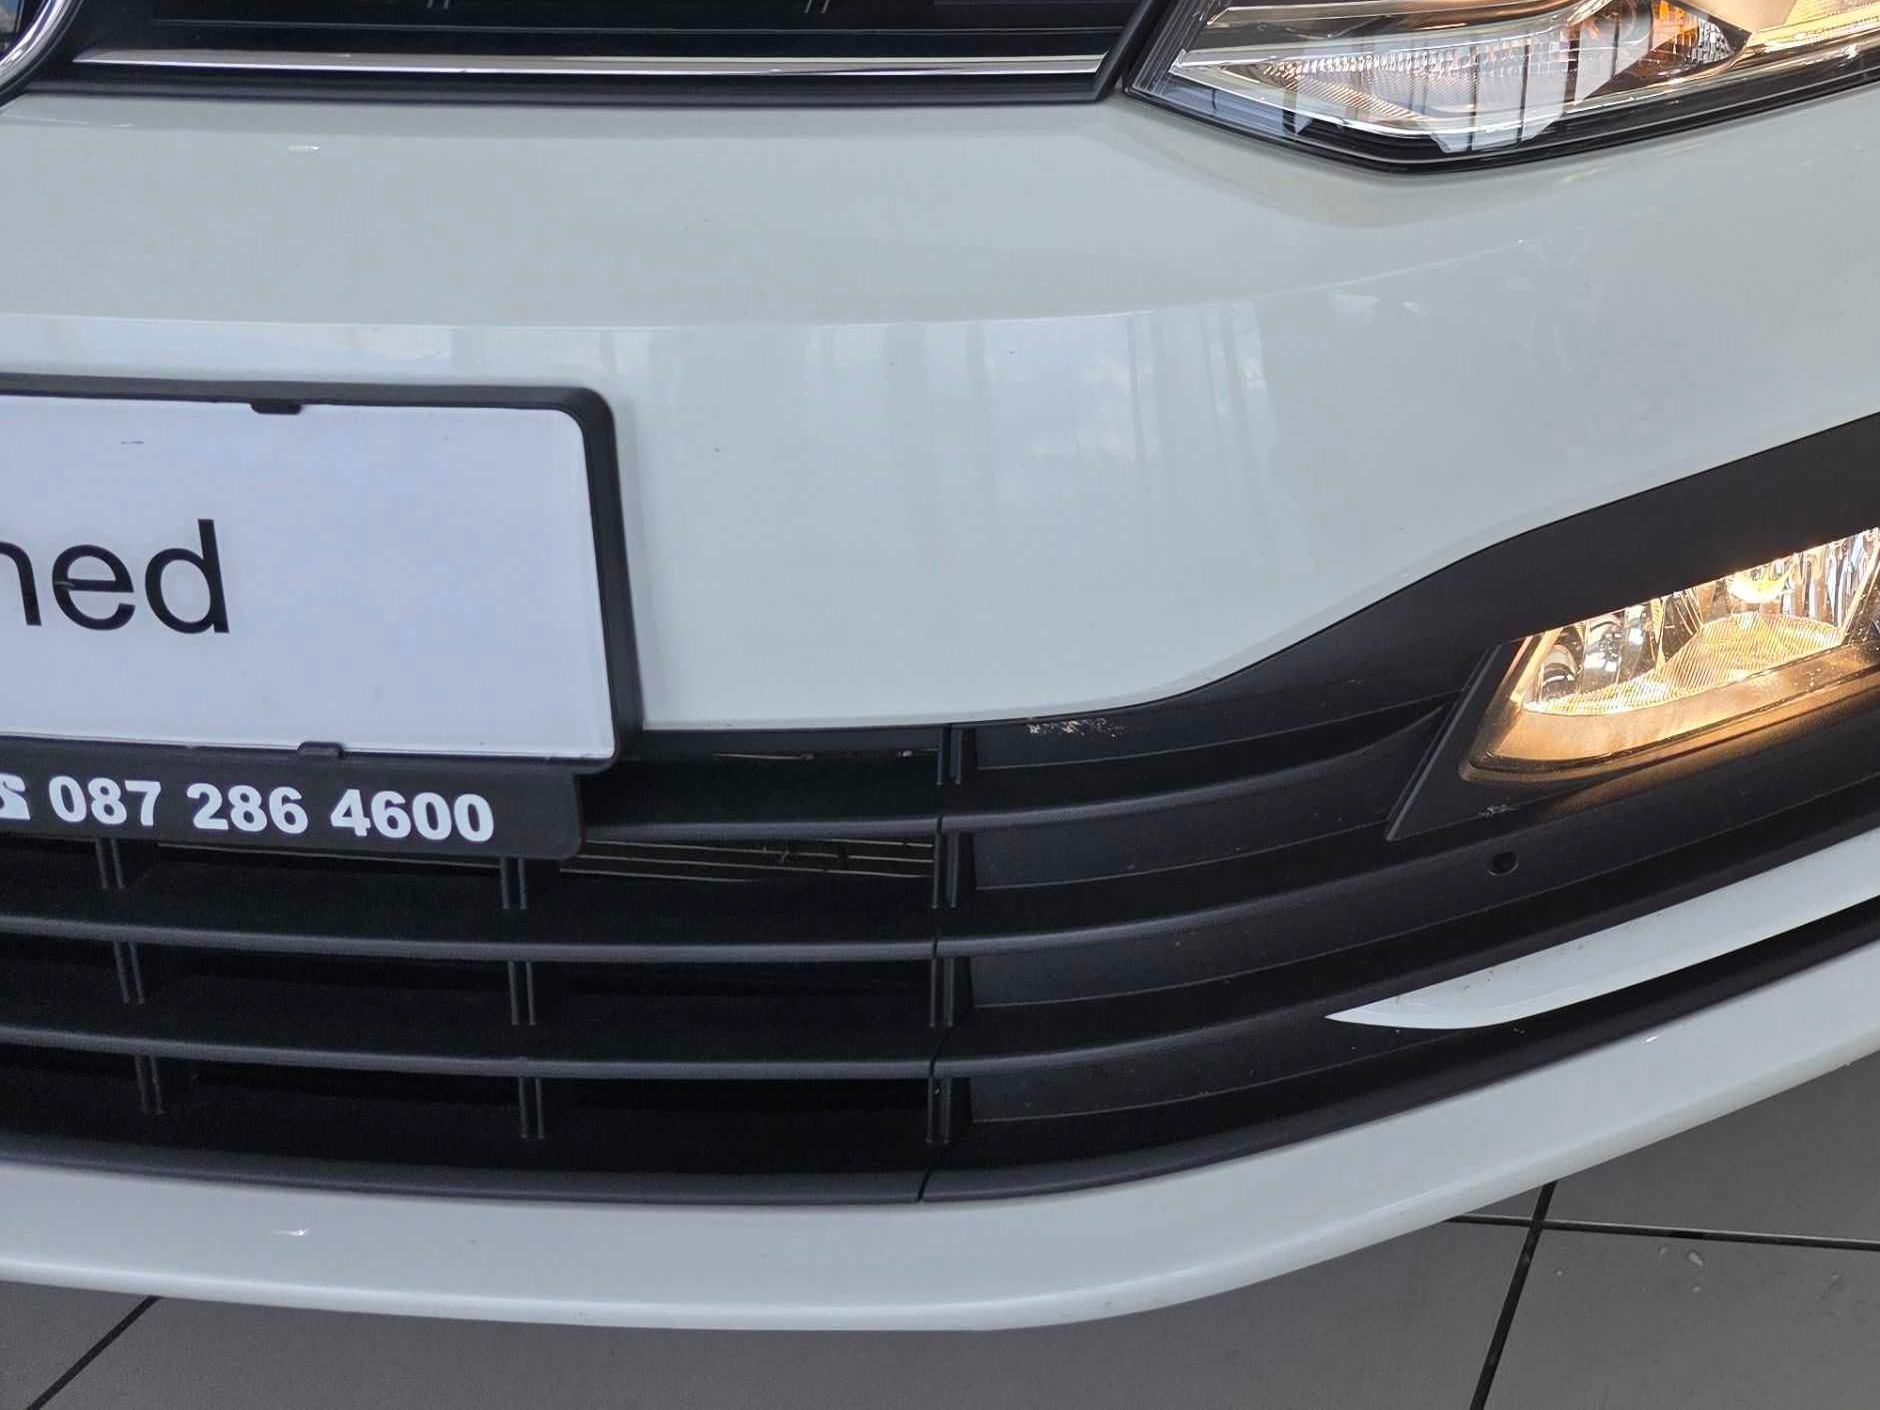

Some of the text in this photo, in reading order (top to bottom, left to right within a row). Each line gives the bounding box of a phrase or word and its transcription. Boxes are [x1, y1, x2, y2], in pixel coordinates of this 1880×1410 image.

[48, 775, 495, 843] 087 286 4600
